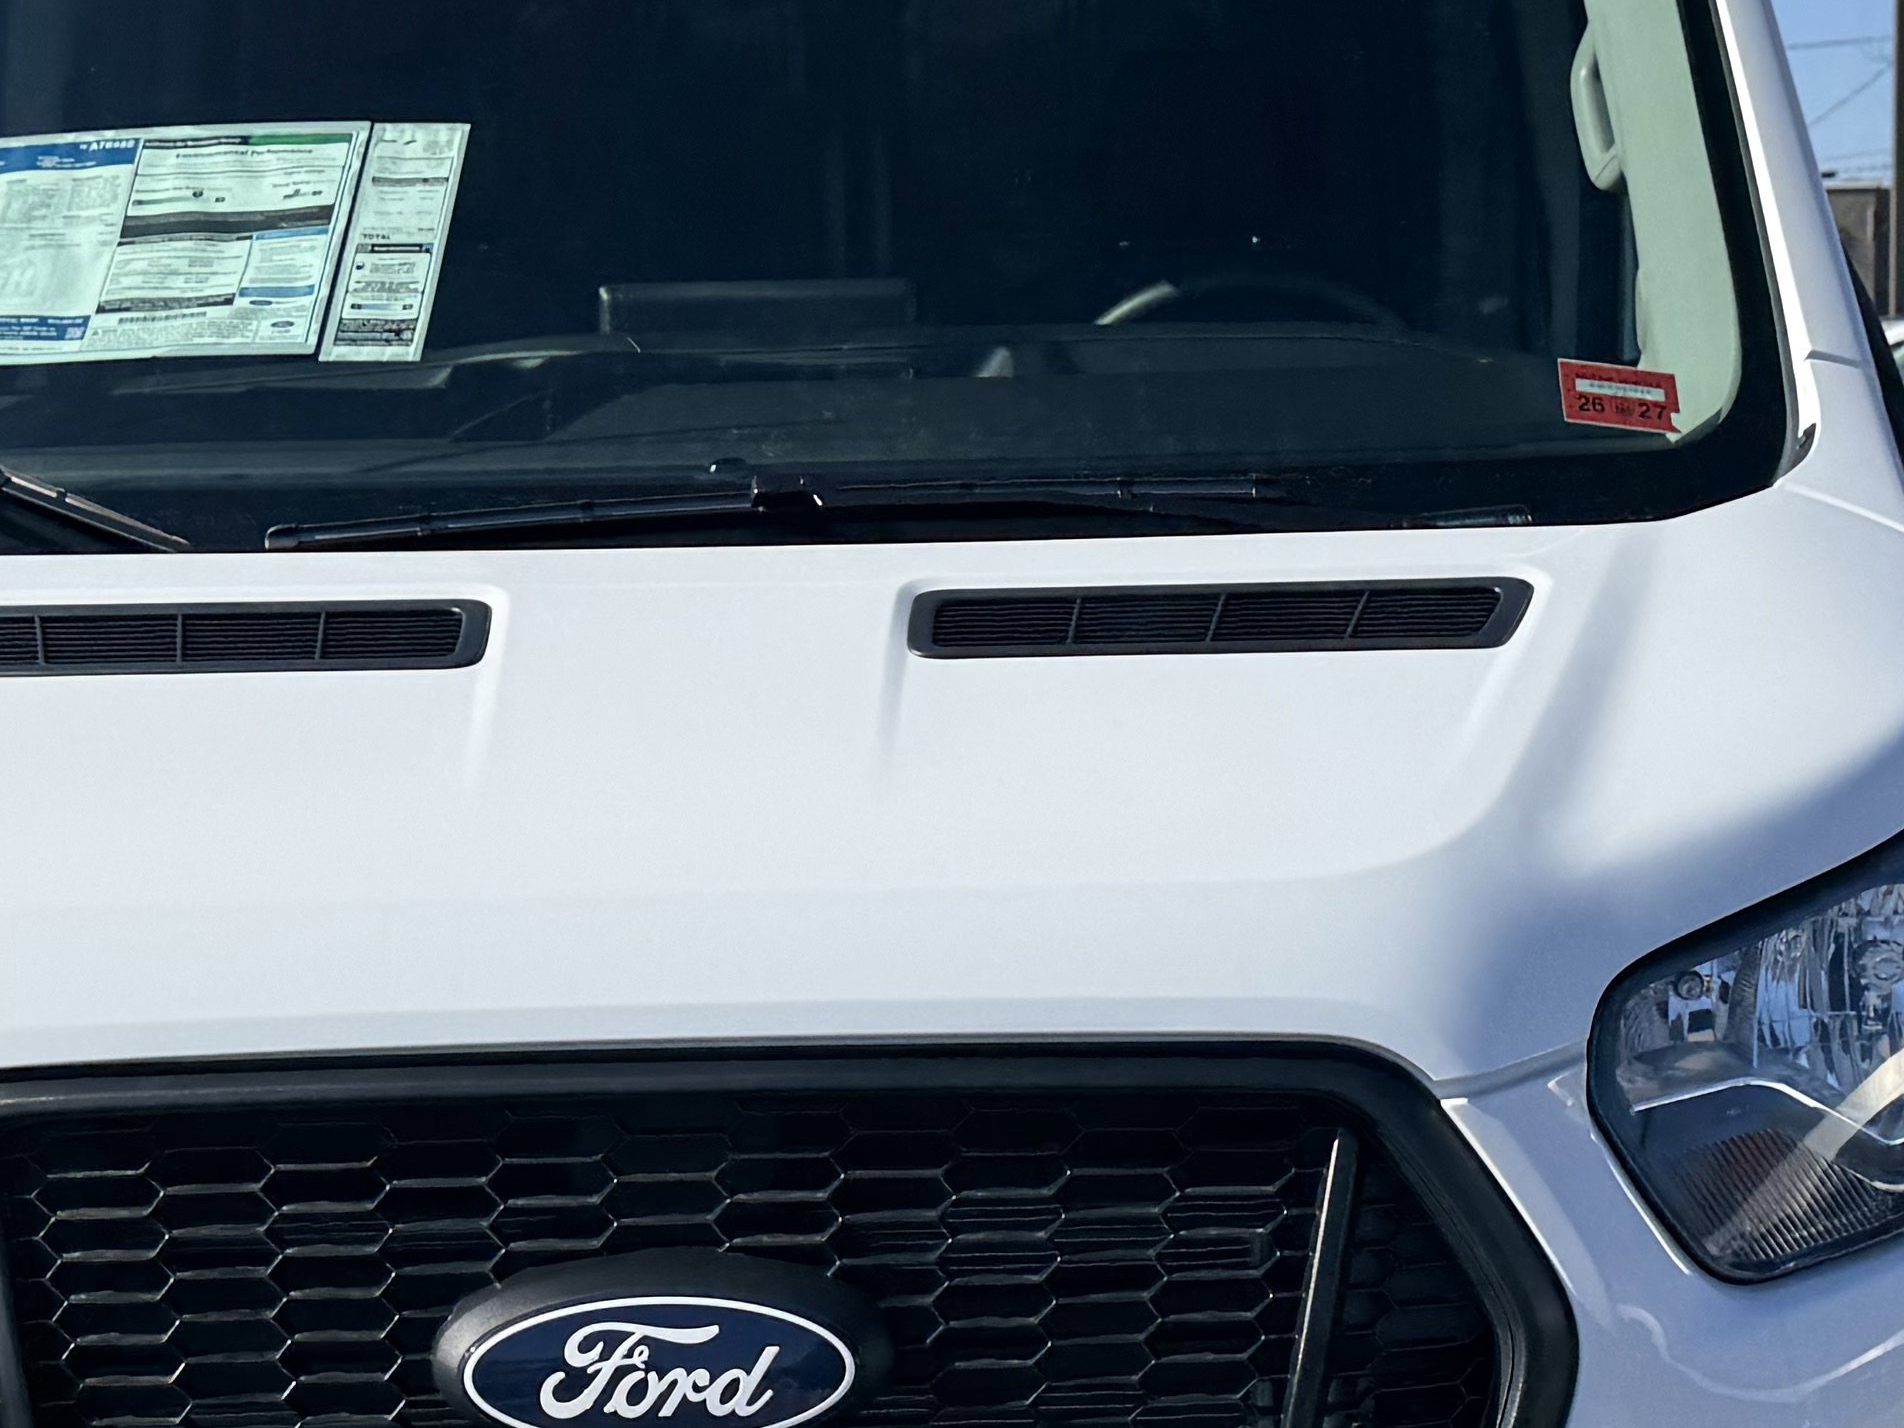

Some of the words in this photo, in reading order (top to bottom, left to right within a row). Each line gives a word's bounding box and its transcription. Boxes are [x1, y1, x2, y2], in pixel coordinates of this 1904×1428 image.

[1577, 395, 1605, 413] 26
[1638, 402, 1667, 420] 27
[539, 1323, 779, 1419] Ford
